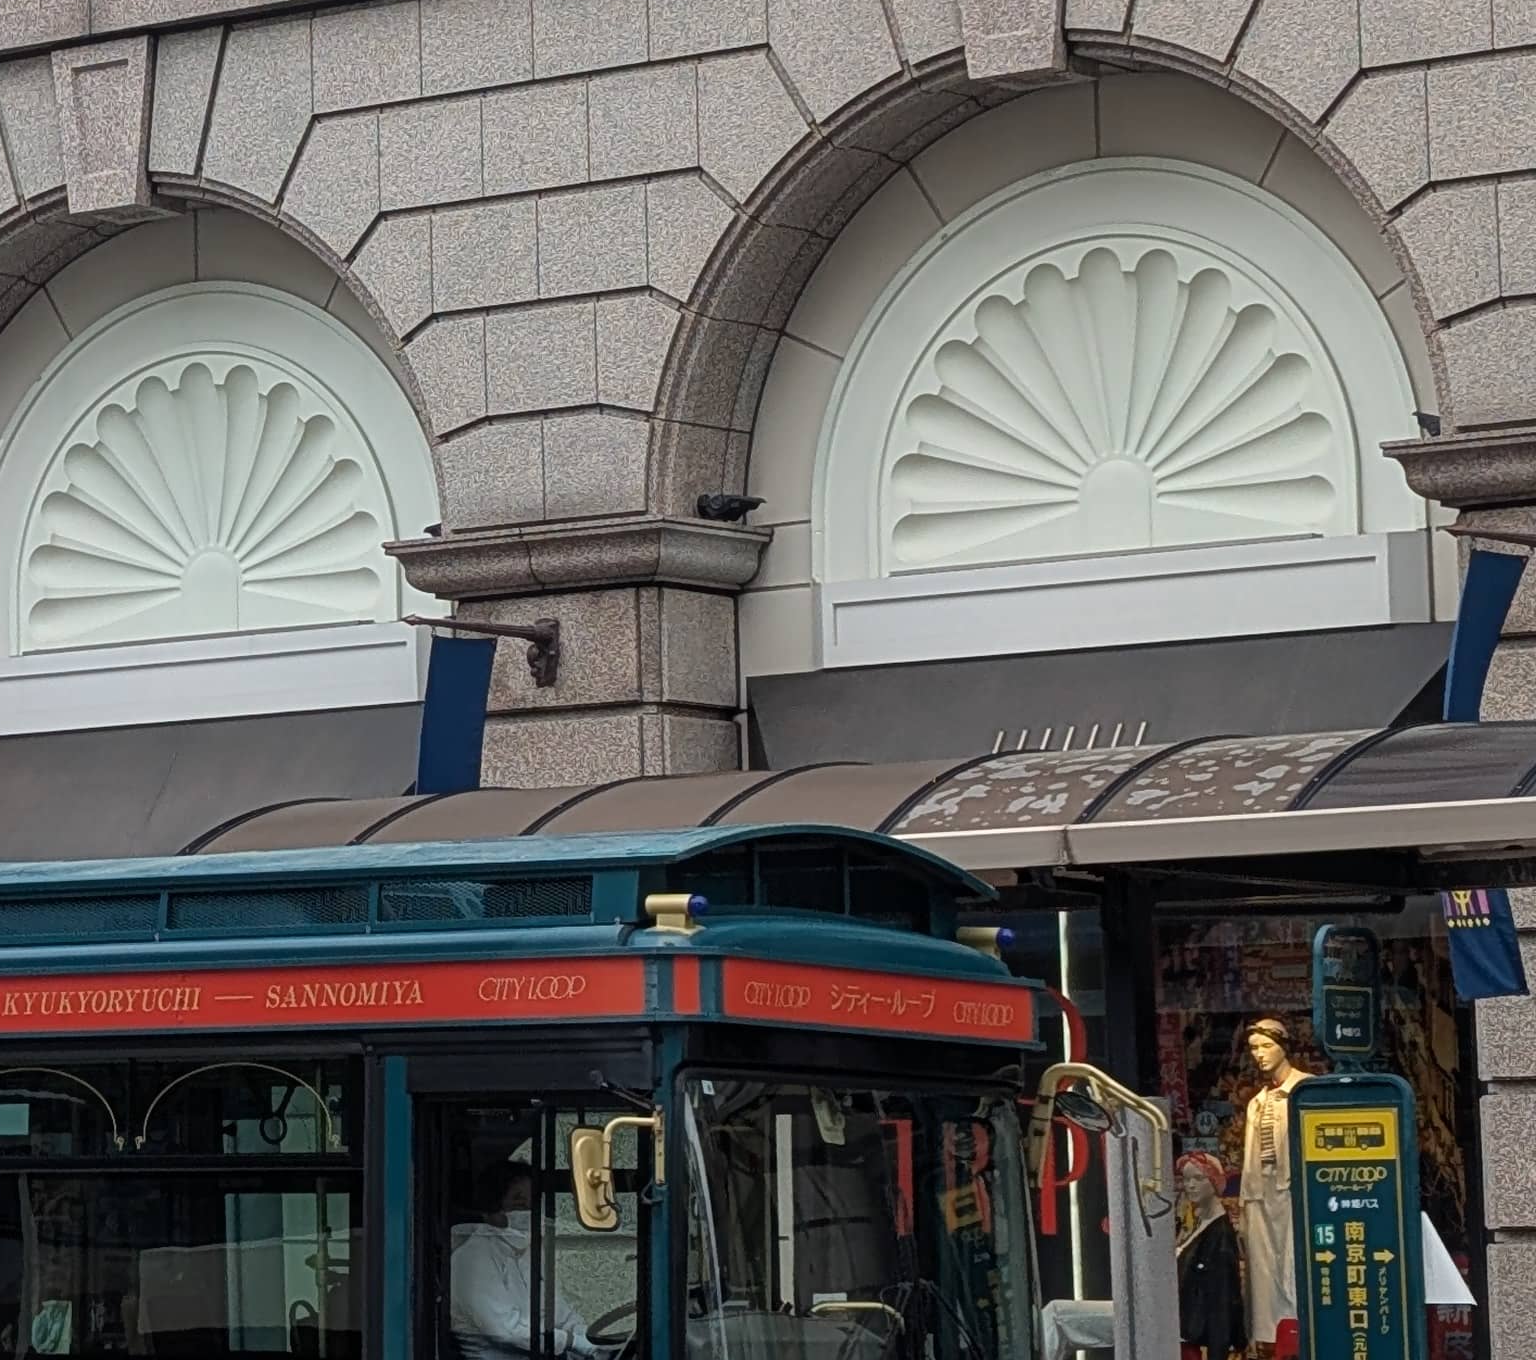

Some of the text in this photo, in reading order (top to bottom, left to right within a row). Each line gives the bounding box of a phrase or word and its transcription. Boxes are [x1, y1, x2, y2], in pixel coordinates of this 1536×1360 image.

[1, 986, 202, 1017] KYUKYORYUCHI
[264, 979, 426, 1009] SANNOMIYA
[477, 975, 587, 1003] CITY LOOP
[1315, 1166, 1388, 1183] CITY LOOP
[1316, 1225, 1335, 1244] 15
[1344, 1221, 1369, 1329] 南京町東口
